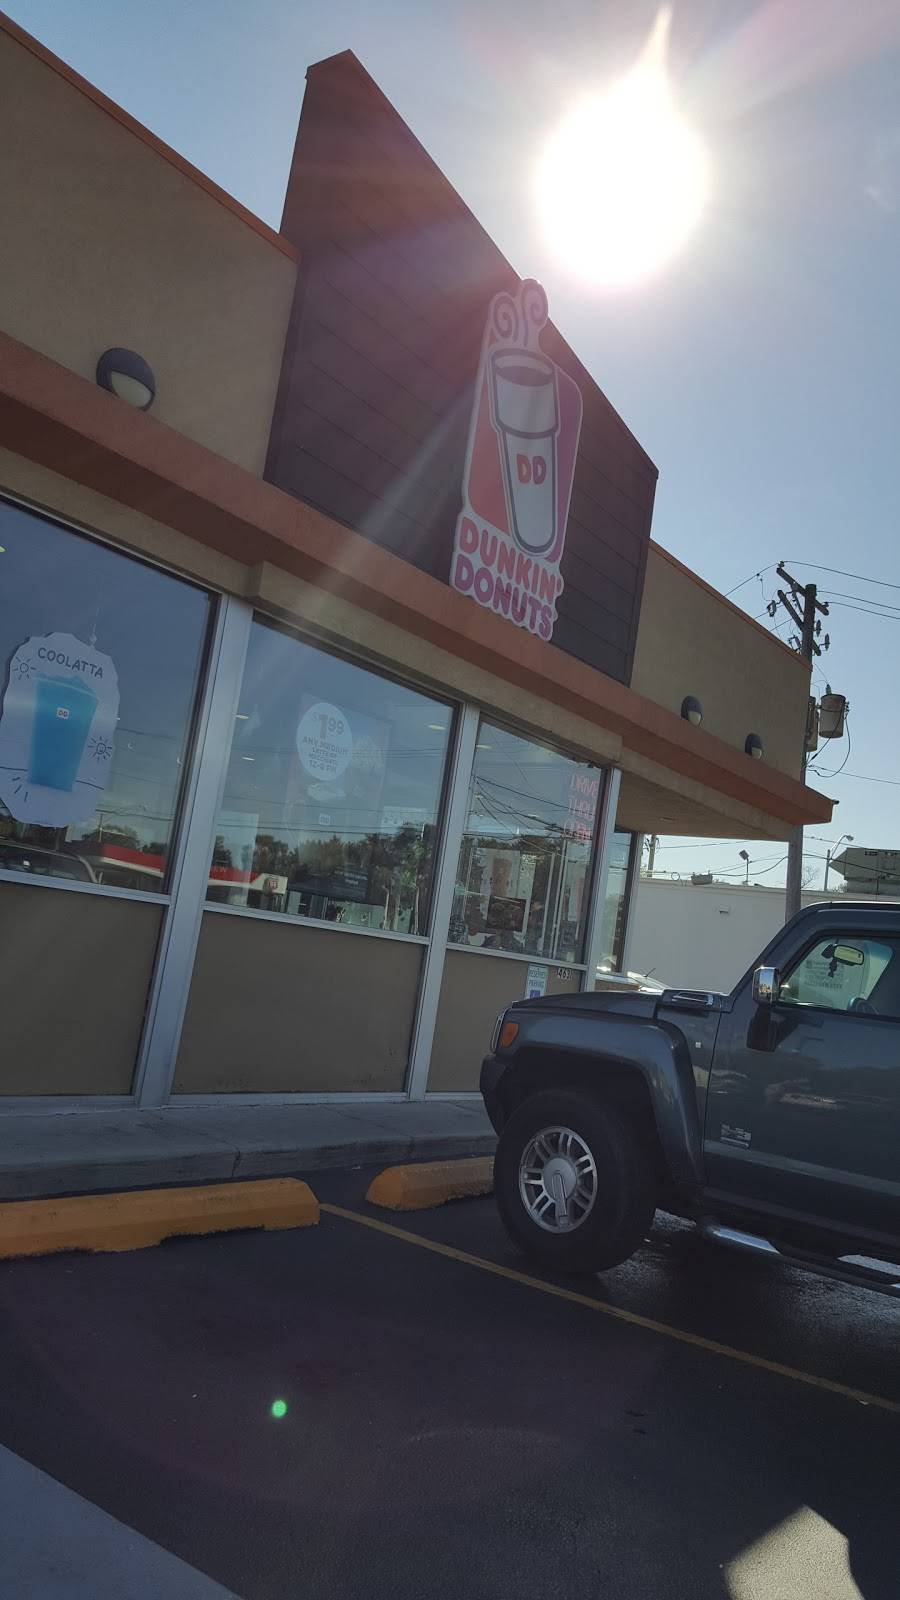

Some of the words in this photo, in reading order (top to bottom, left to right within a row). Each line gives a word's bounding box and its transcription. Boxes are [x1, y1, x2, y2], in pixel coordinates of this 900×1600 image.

[517, 453, 547, 485] DD
[459, 516, 562, 605] DUNKIN'
[454, 553, 552, 639] DONUTS
[38, 647, 104, 678] COOLATTA
